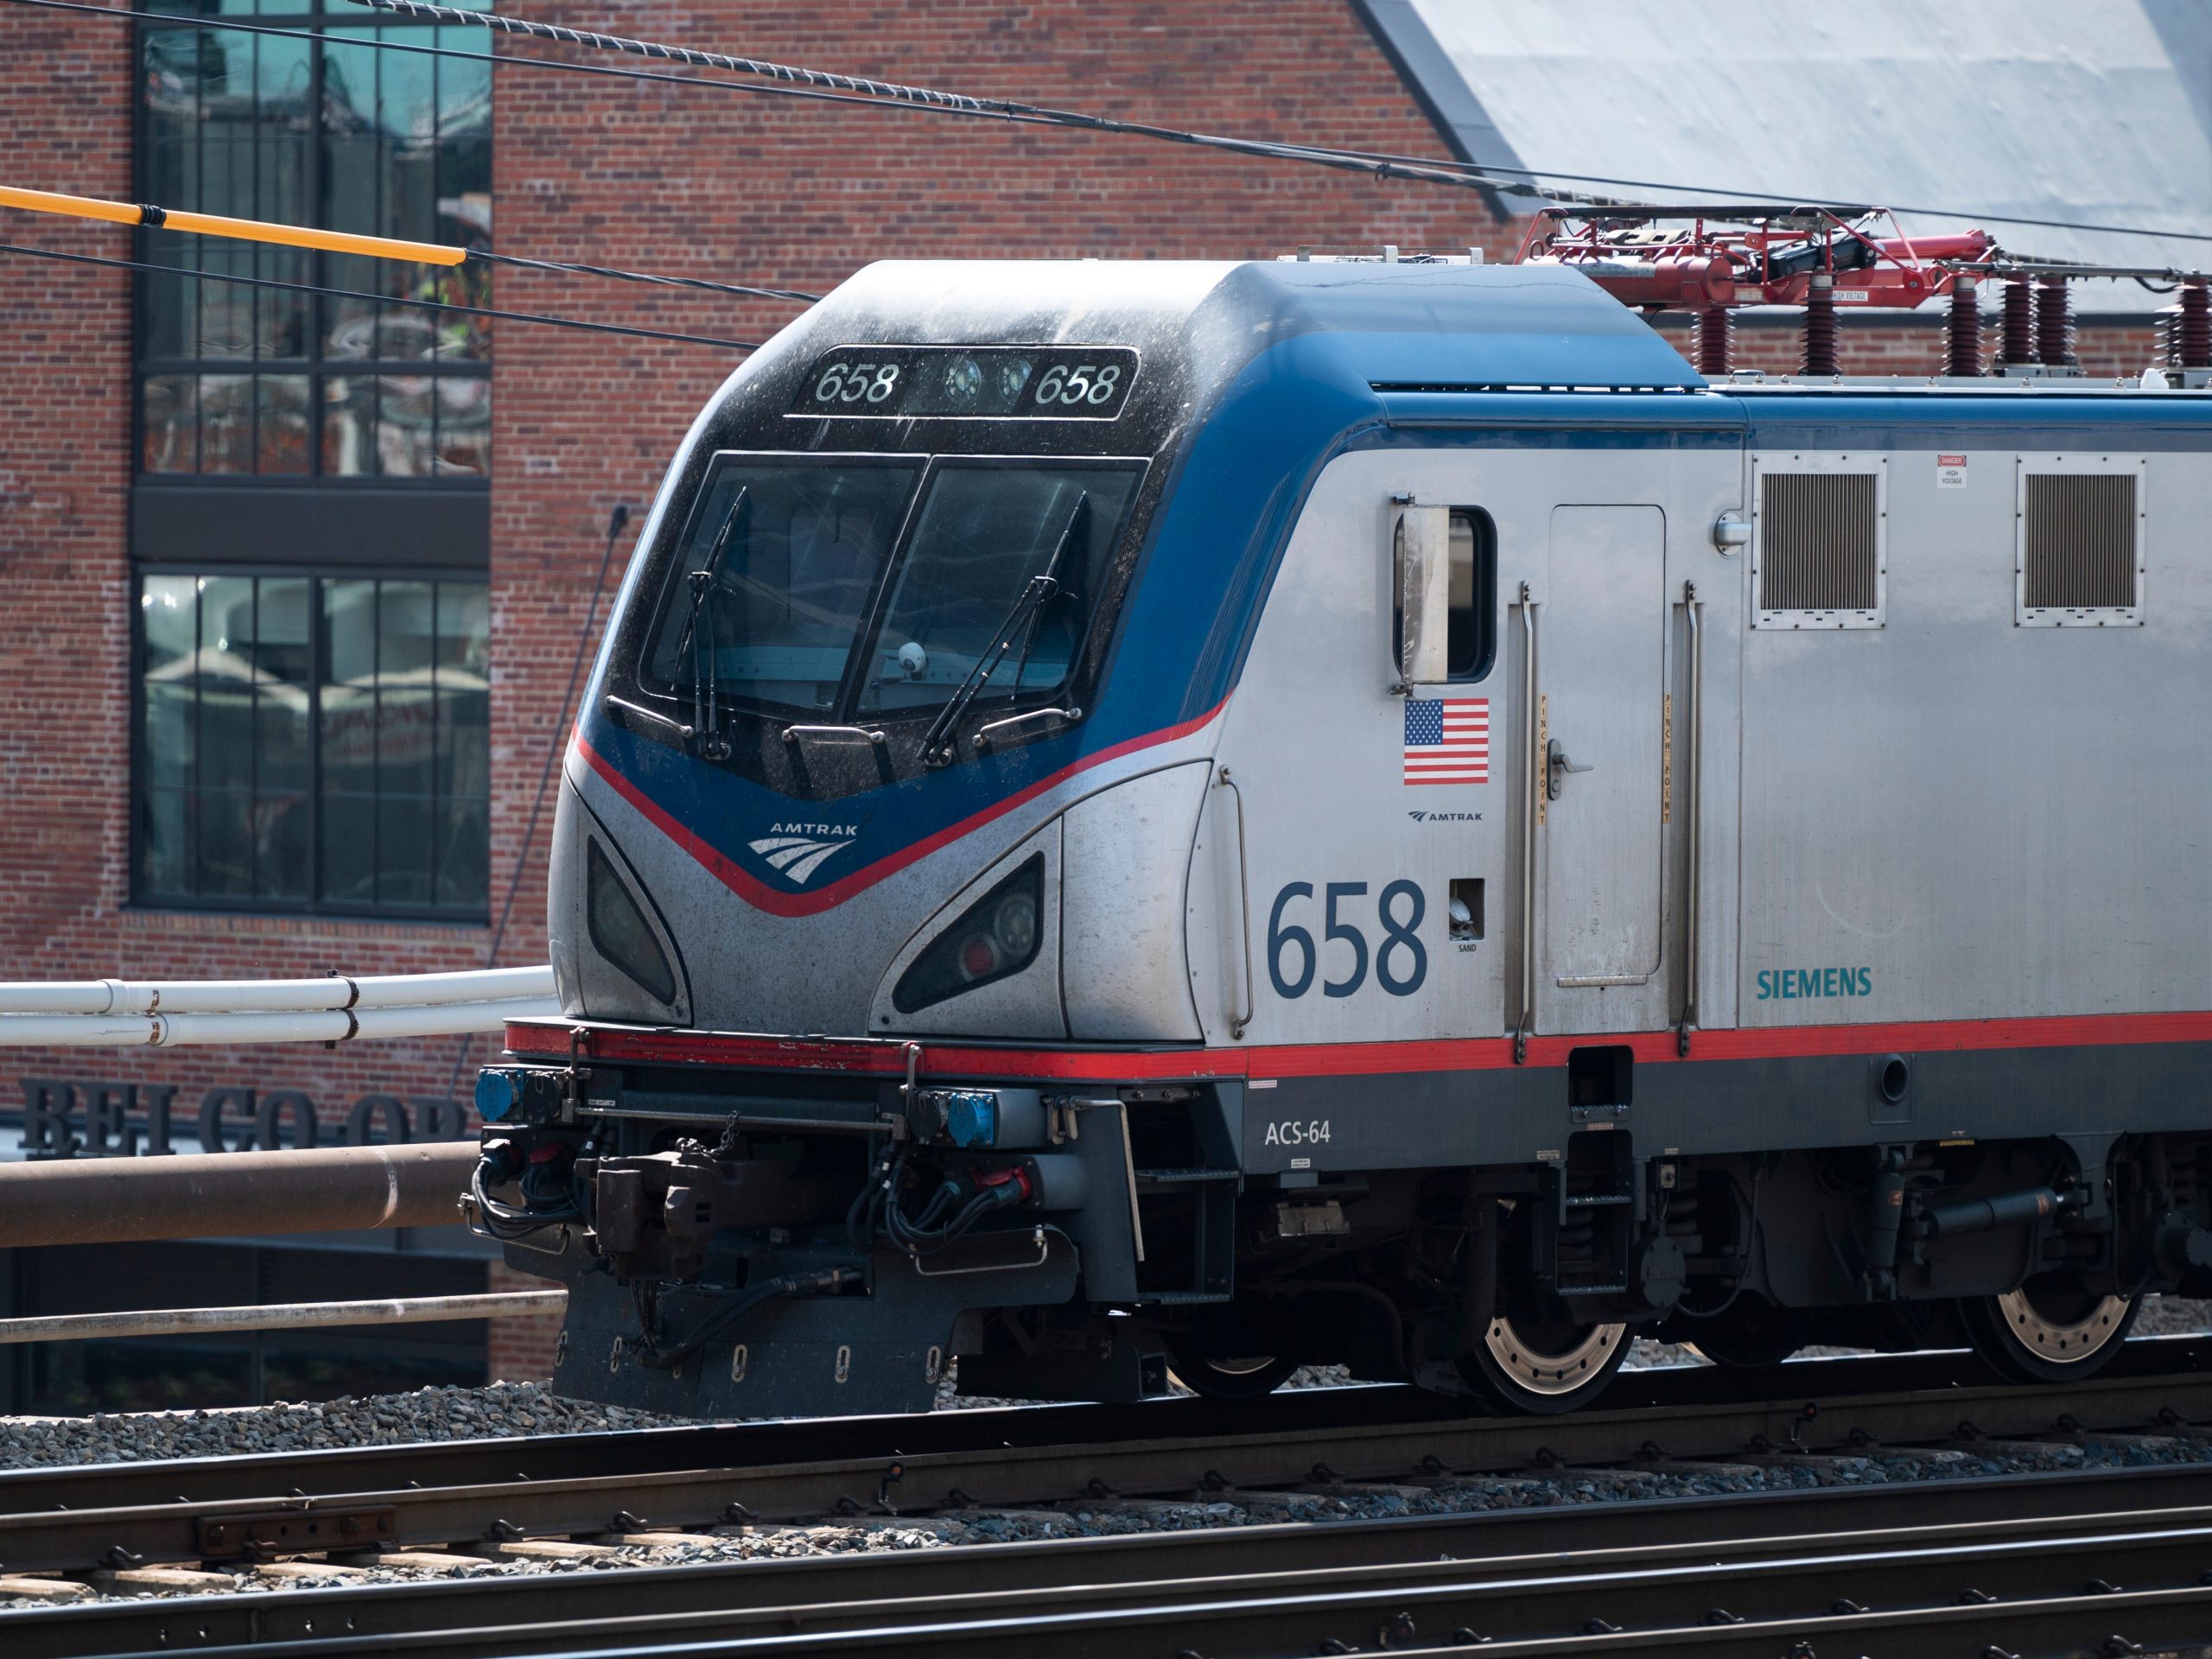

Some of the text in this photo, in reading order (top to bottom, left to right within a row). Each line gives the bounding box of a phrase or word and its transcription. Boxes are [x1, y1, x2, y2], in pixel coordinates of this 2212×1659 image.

[1833, 290, 1866, 301] HIGH VOLTAGE
[815, 362, 899, 403] 658
[1035, 365, 1122, 404] 658
[770, 823, 858, 836] AMTRAK
[1268, 879, 1427, 1000] 658
[1459, 944, 1477, 953] SAND
[1757, 966, 1872, 1000] SIEMENS
[17, 1077, 180, 1156] REI
[1264, 1120, 1331, 1146] ACS-64
